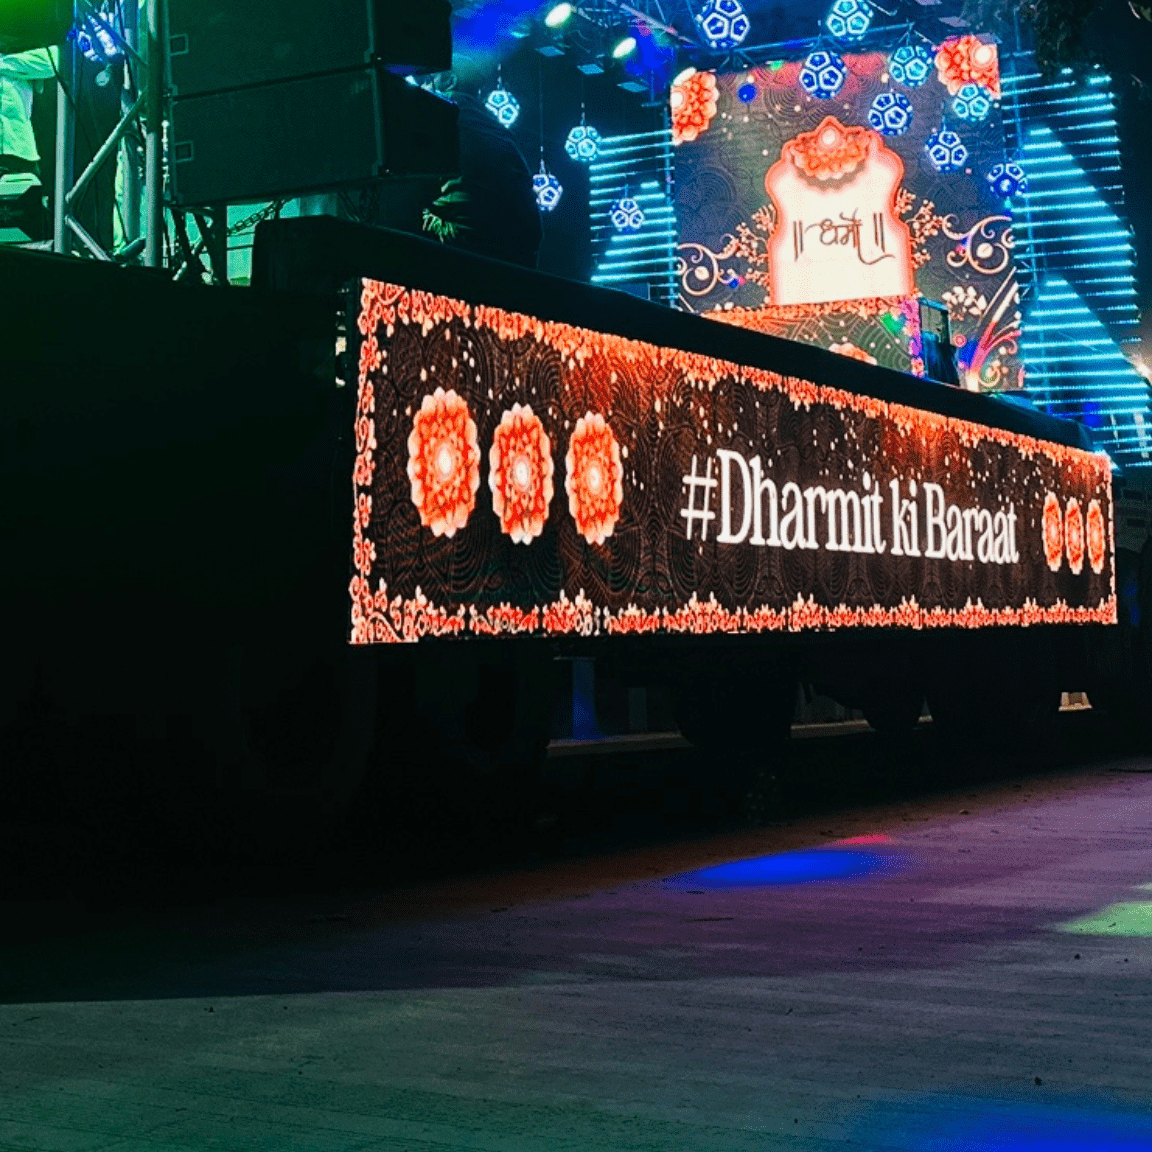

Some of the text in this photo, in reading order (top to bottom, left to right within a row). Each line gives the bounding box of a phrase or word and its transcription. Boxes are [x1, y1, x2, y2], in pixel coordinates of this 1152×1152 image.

[680, 448, 1020, 565] #Dharmit ki Baraat
